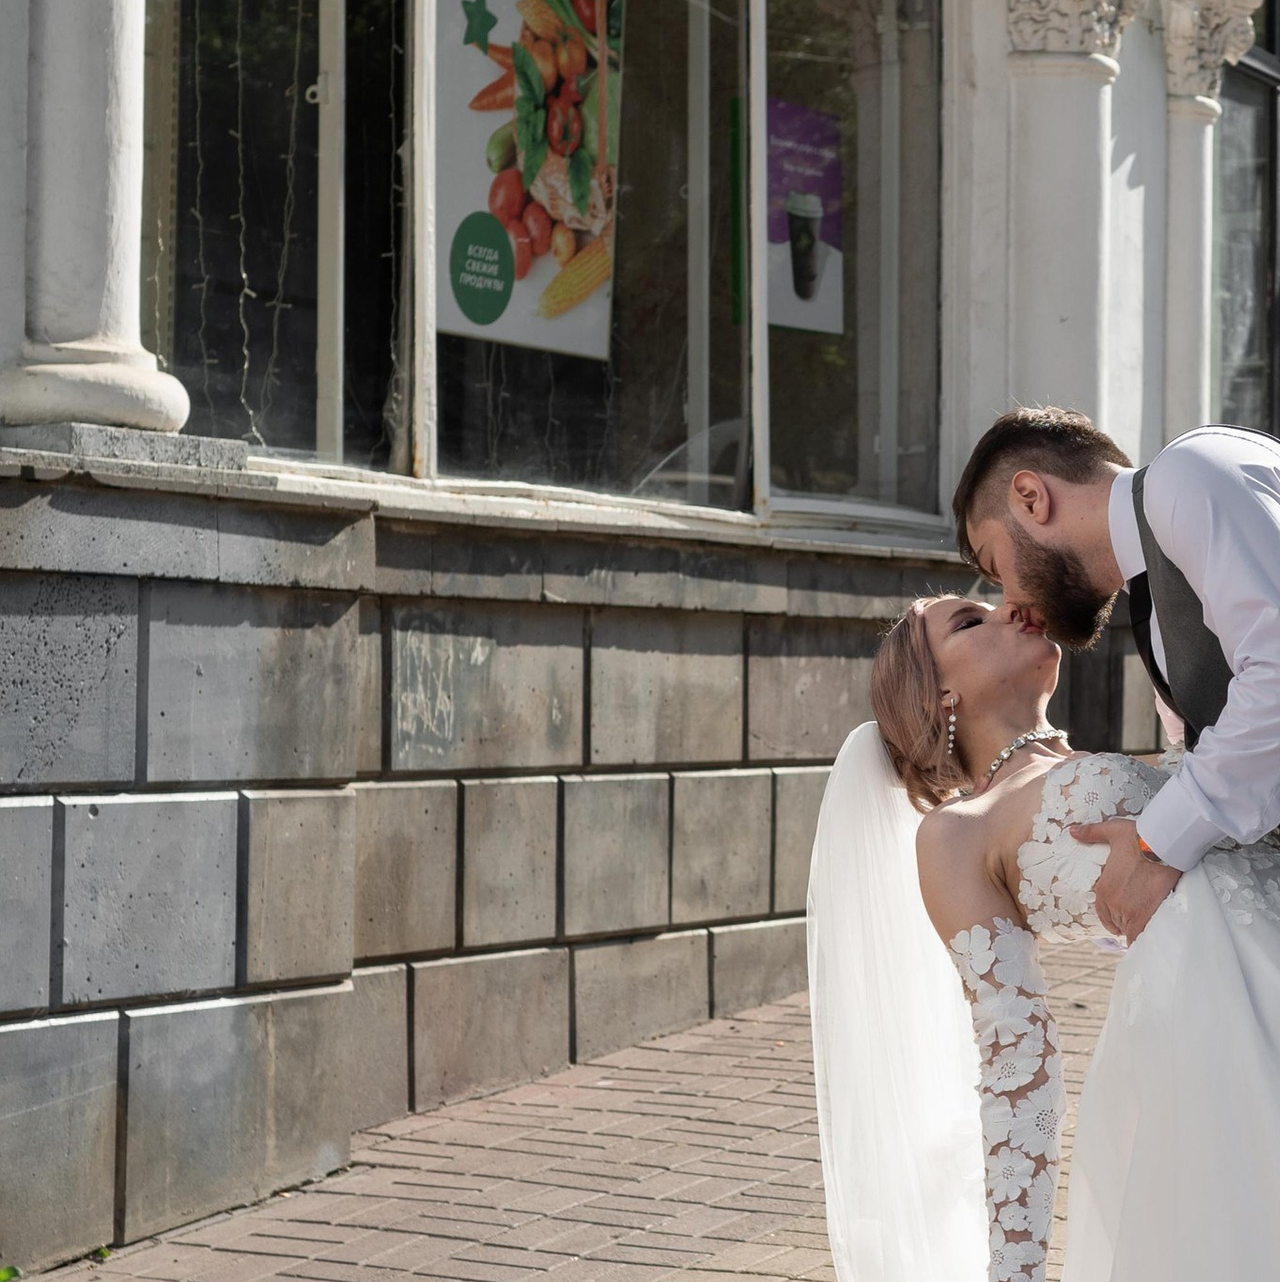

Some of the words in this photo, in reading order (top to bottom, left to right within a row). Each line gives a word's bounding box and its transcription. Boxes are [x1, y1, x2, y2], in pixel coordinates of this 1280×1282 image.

[467, 244, 499, 260] ВСЕГДА
[465, 258, 499, 276] СВЕЖИЕ
[459, 272, 505, 291] ПРОДУКТЫ
